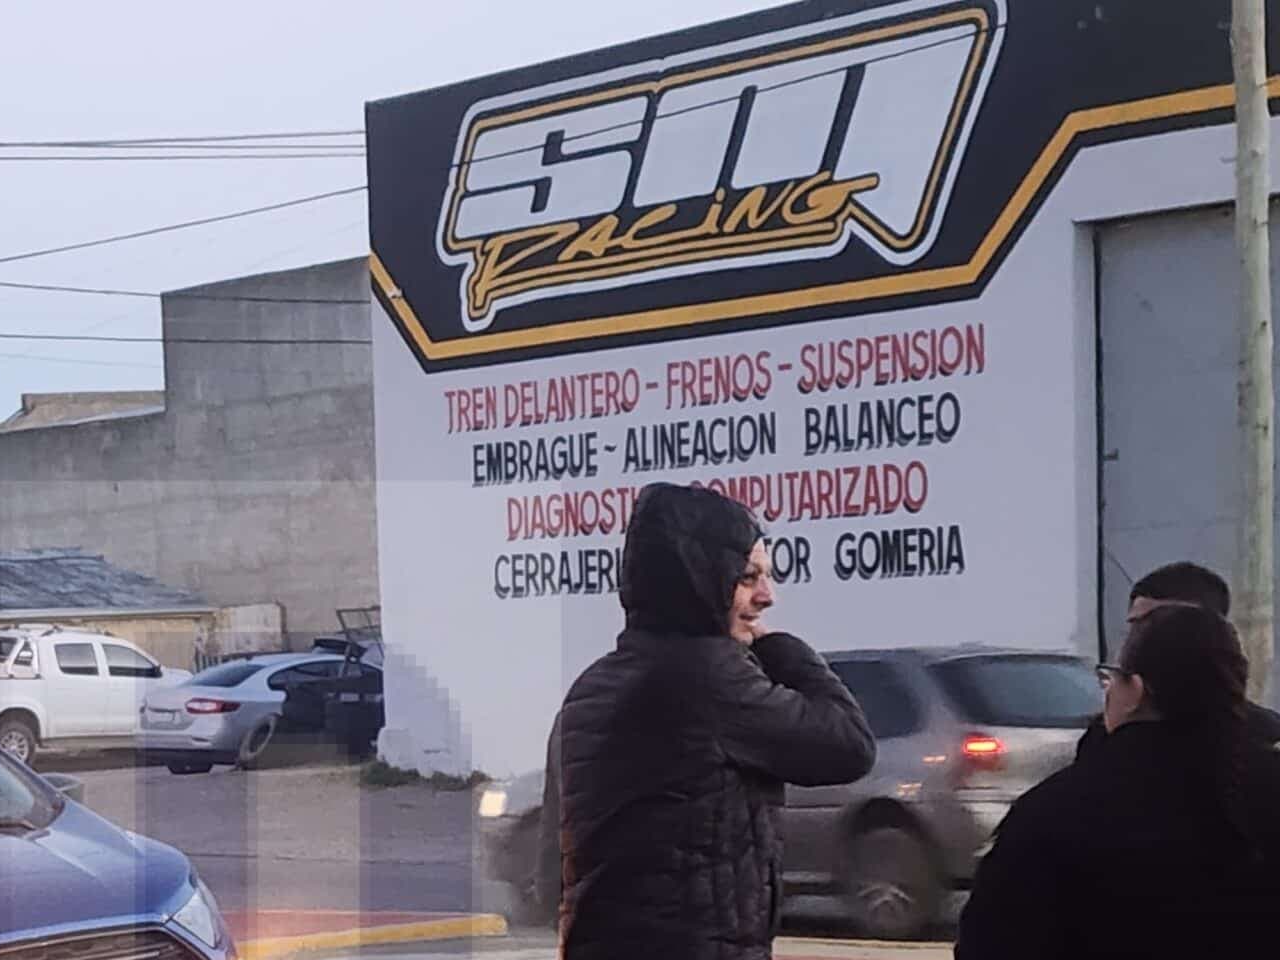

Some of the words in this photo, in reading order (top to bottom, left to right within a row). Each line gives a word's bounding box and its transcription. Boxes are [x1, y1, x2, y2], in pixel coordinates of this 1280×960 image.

[445, 385, 497, 434] TREN
[503, 367, 640, 428] DELANTERO
[666, 351, 772, 410] FRENOS
[797, 323, 985, 394] SUSPENSION
[472, 432, 599, 487] EMBRAGUE
[622, 411, 777, 474] ALINEACION
[804, 391, 961, 456] BALANCEO
[494, 546, 621, 599] CERRAJERI
[833, 524, 965, 581] GOMERIA
